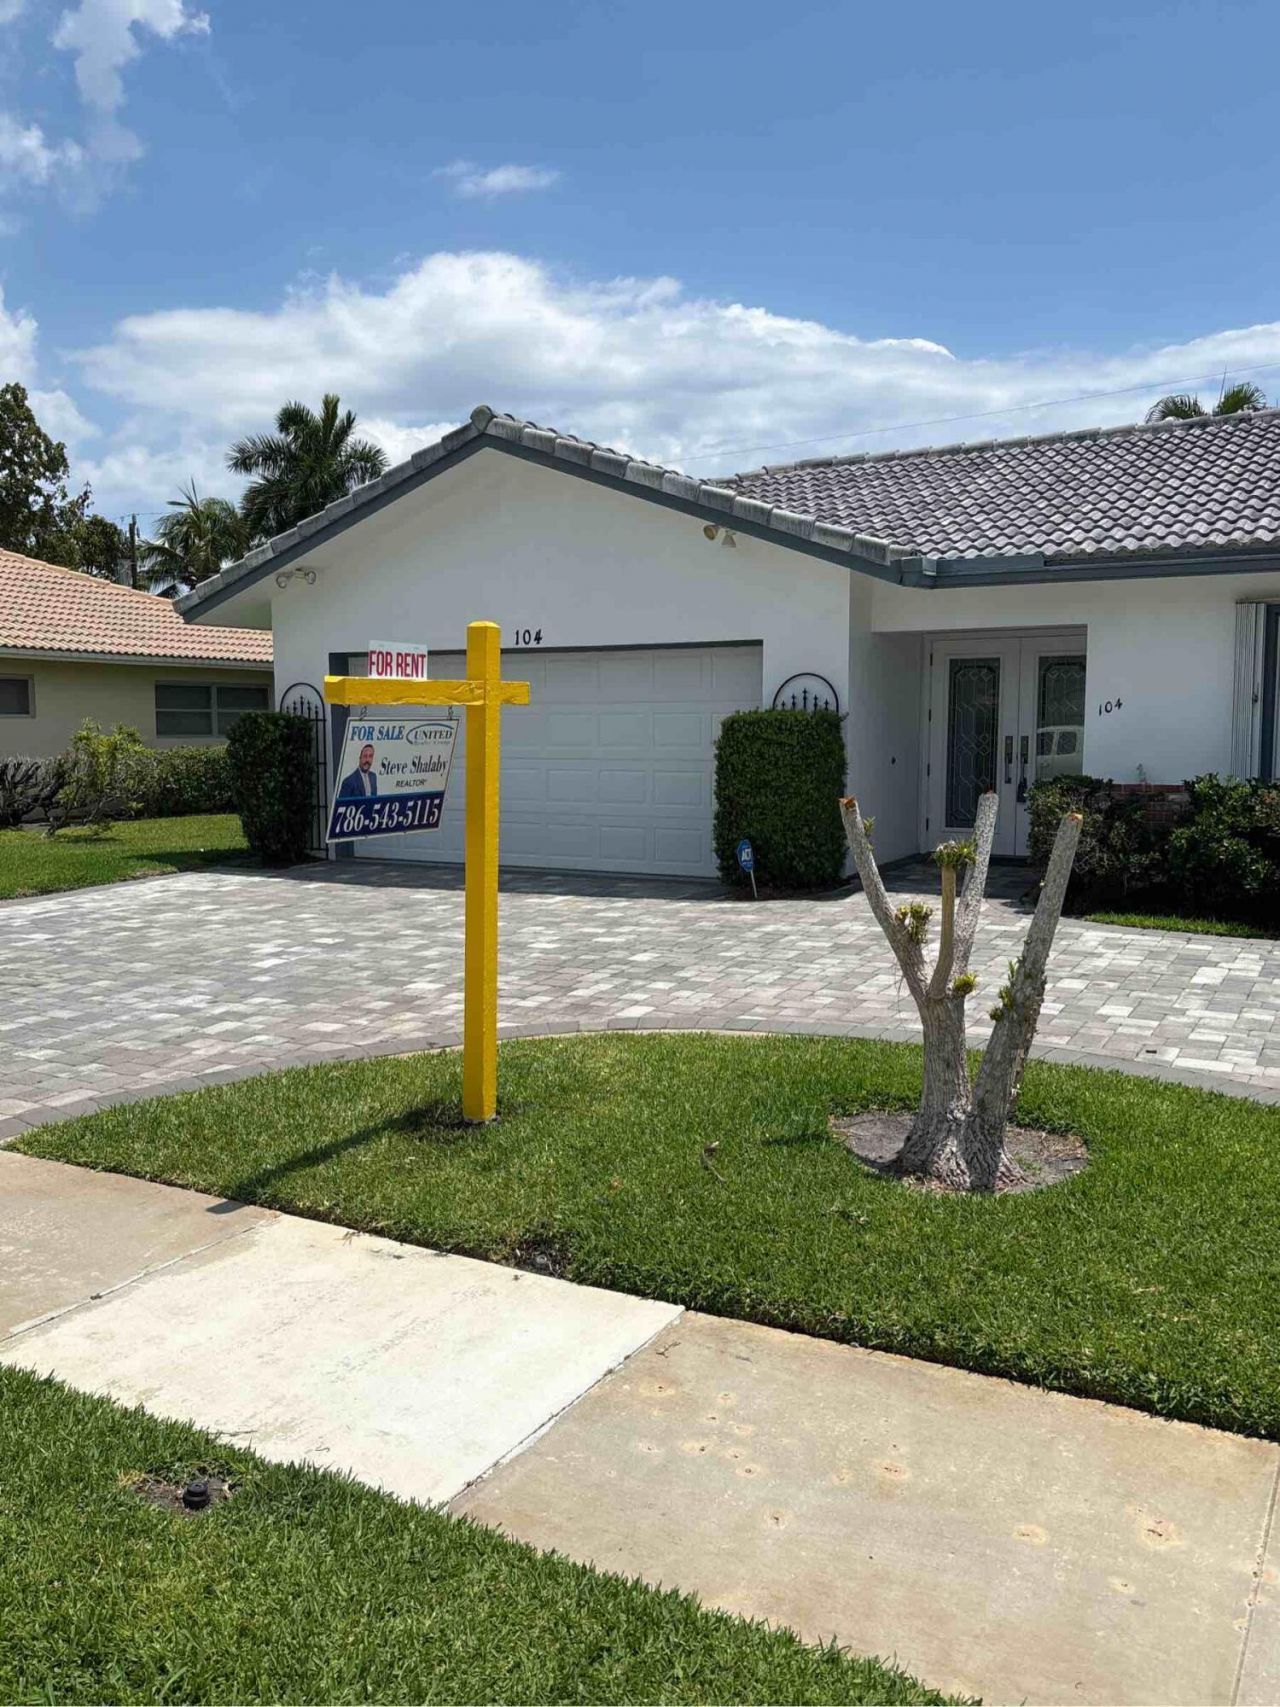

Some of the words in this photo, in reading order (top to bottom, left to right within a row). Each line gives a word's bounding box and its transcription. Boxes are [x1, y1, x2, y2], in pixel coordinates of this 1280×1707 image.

[514, 629, 543, 646] 104
[368, 650, 393, 677] FOR
[395, 652, 427, 678] RENT
[1098, 698, 1123, 716] 104
[350, 725, 375, 741] FOR
[376, 725, 405, 740] SALE
[414, 729, 453, 740] UNITED
[379, 756, 408, 776] Steve
[409, 754, 448, 777] Shalaby
[335, 798, 441, 834] 786-543-5115
